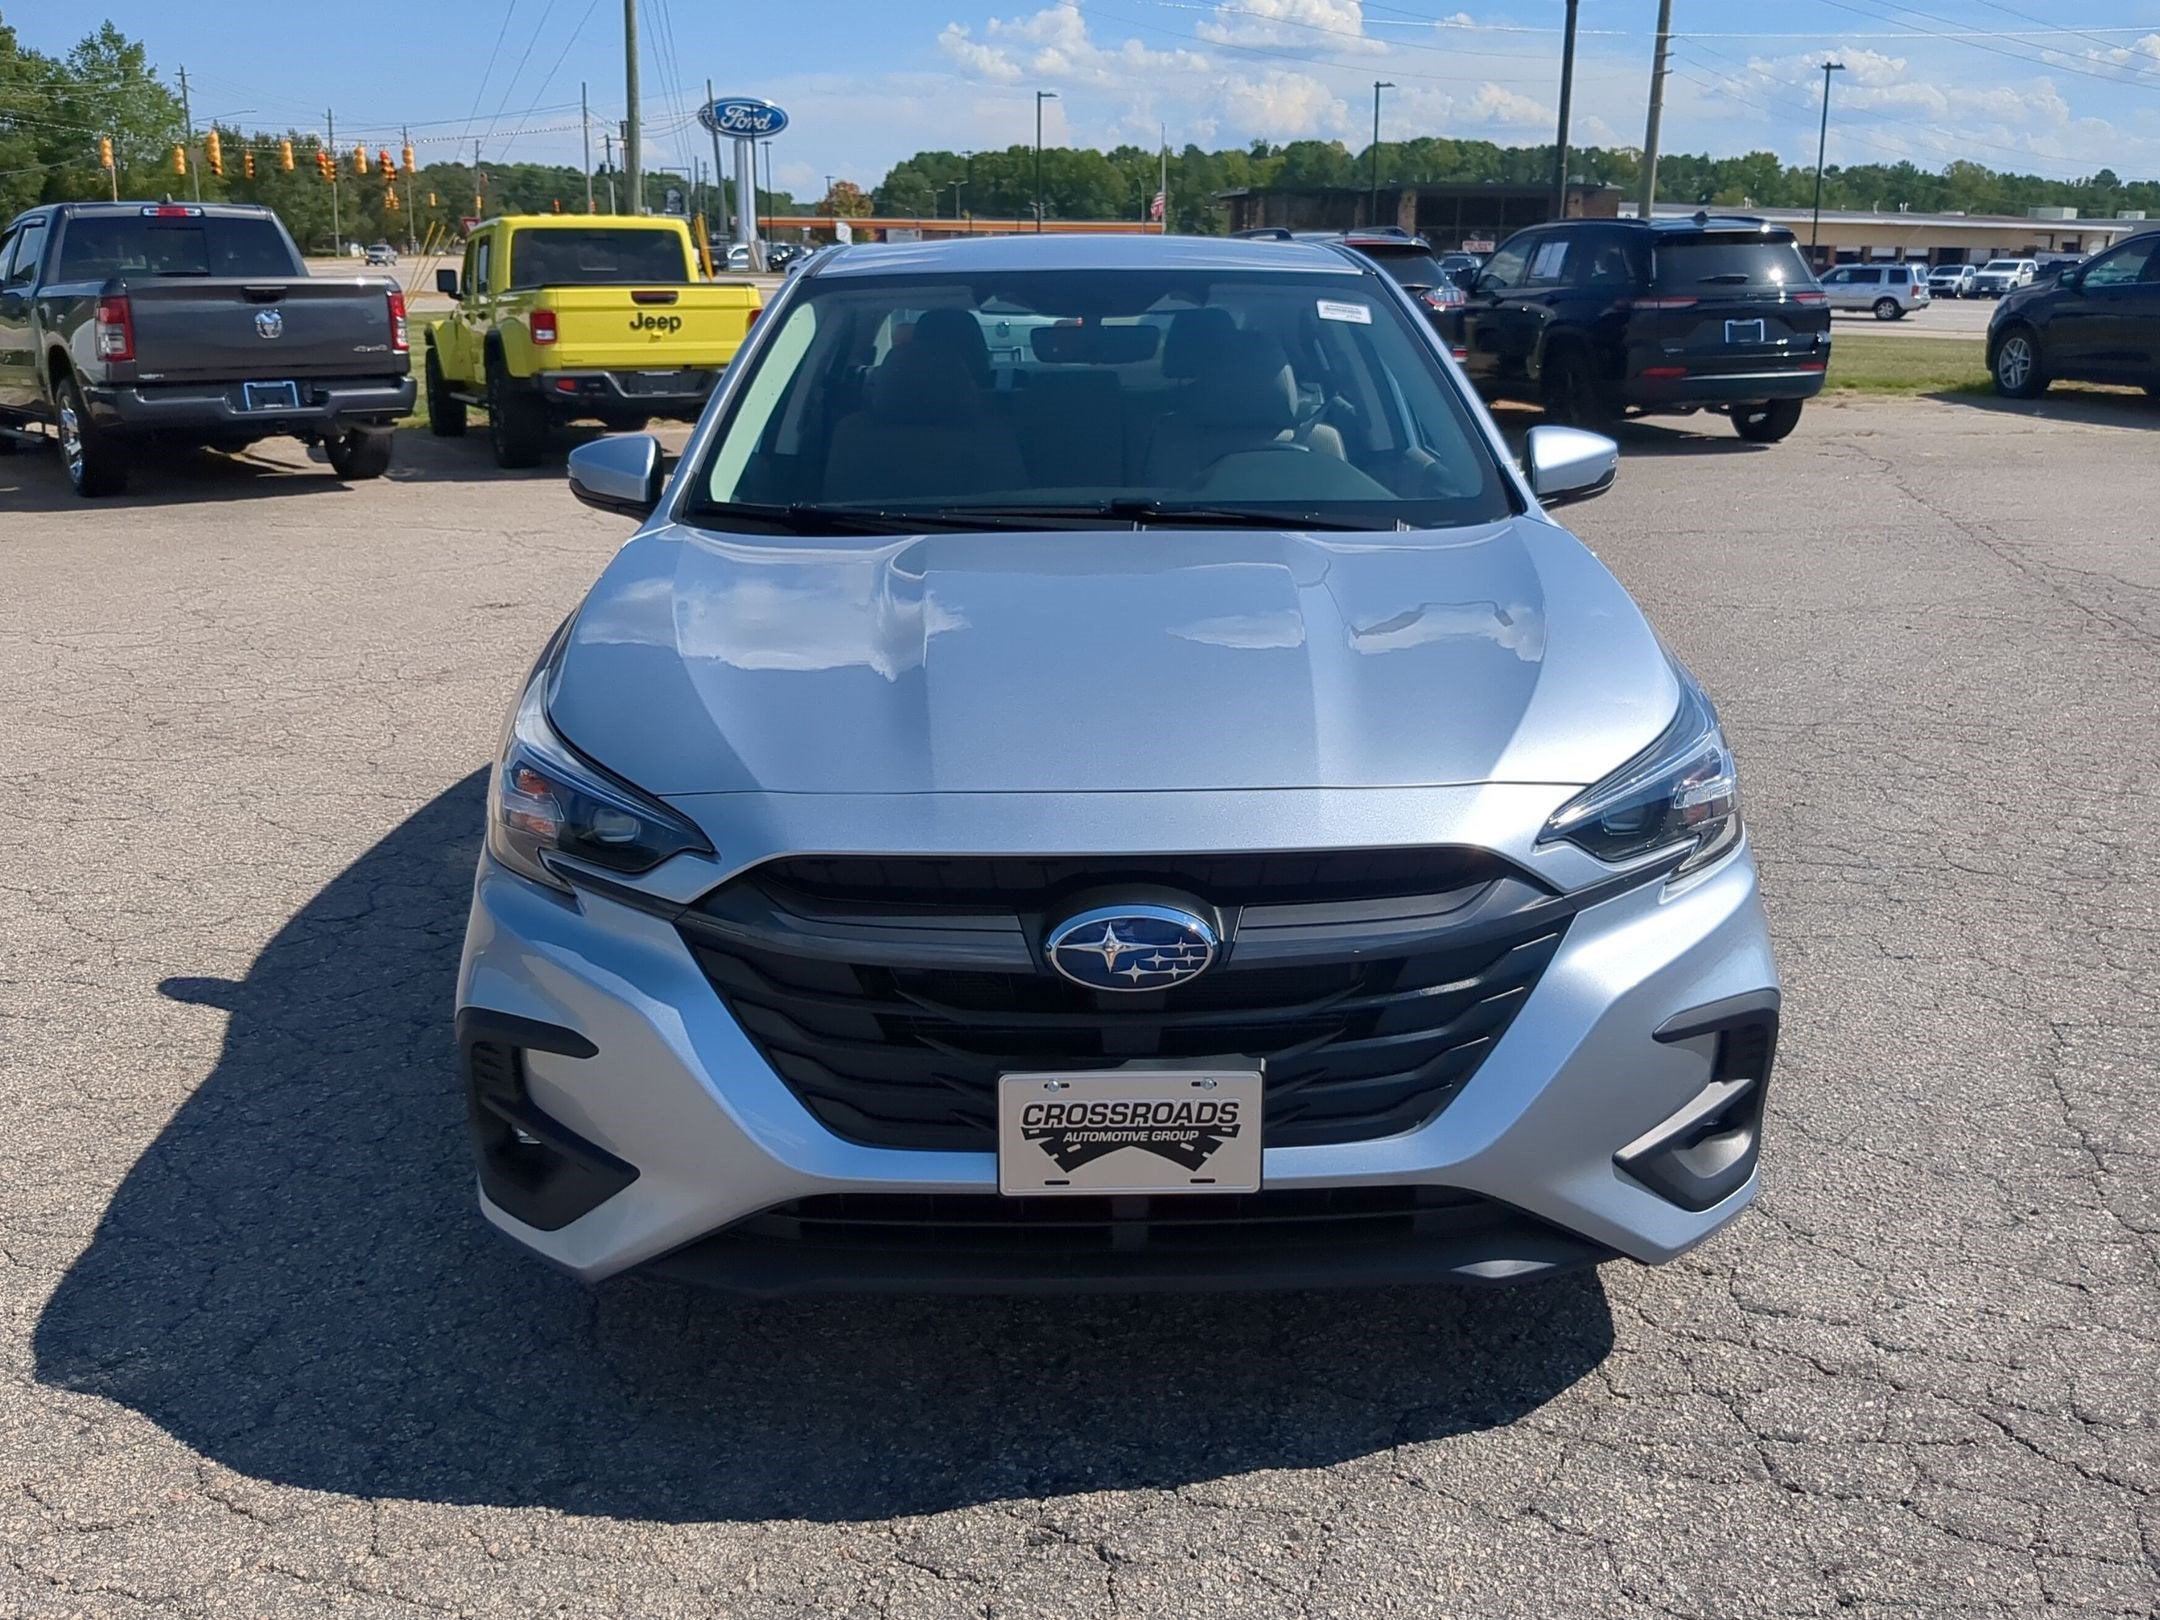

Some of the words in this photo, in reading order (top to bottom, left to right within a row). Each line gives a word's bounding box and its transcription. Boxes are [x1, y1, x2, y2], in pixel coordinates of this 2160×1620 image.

[720, 105, 772, 130] Ford
[629, 311, 682, 334] Jeep
[1021, 1101, 1240, 1128] CROSSROADS
[1062, 1131, 1148, 1143] AUTOMOTIVE
[1151, 1130, 1200, 1141] GROUP
